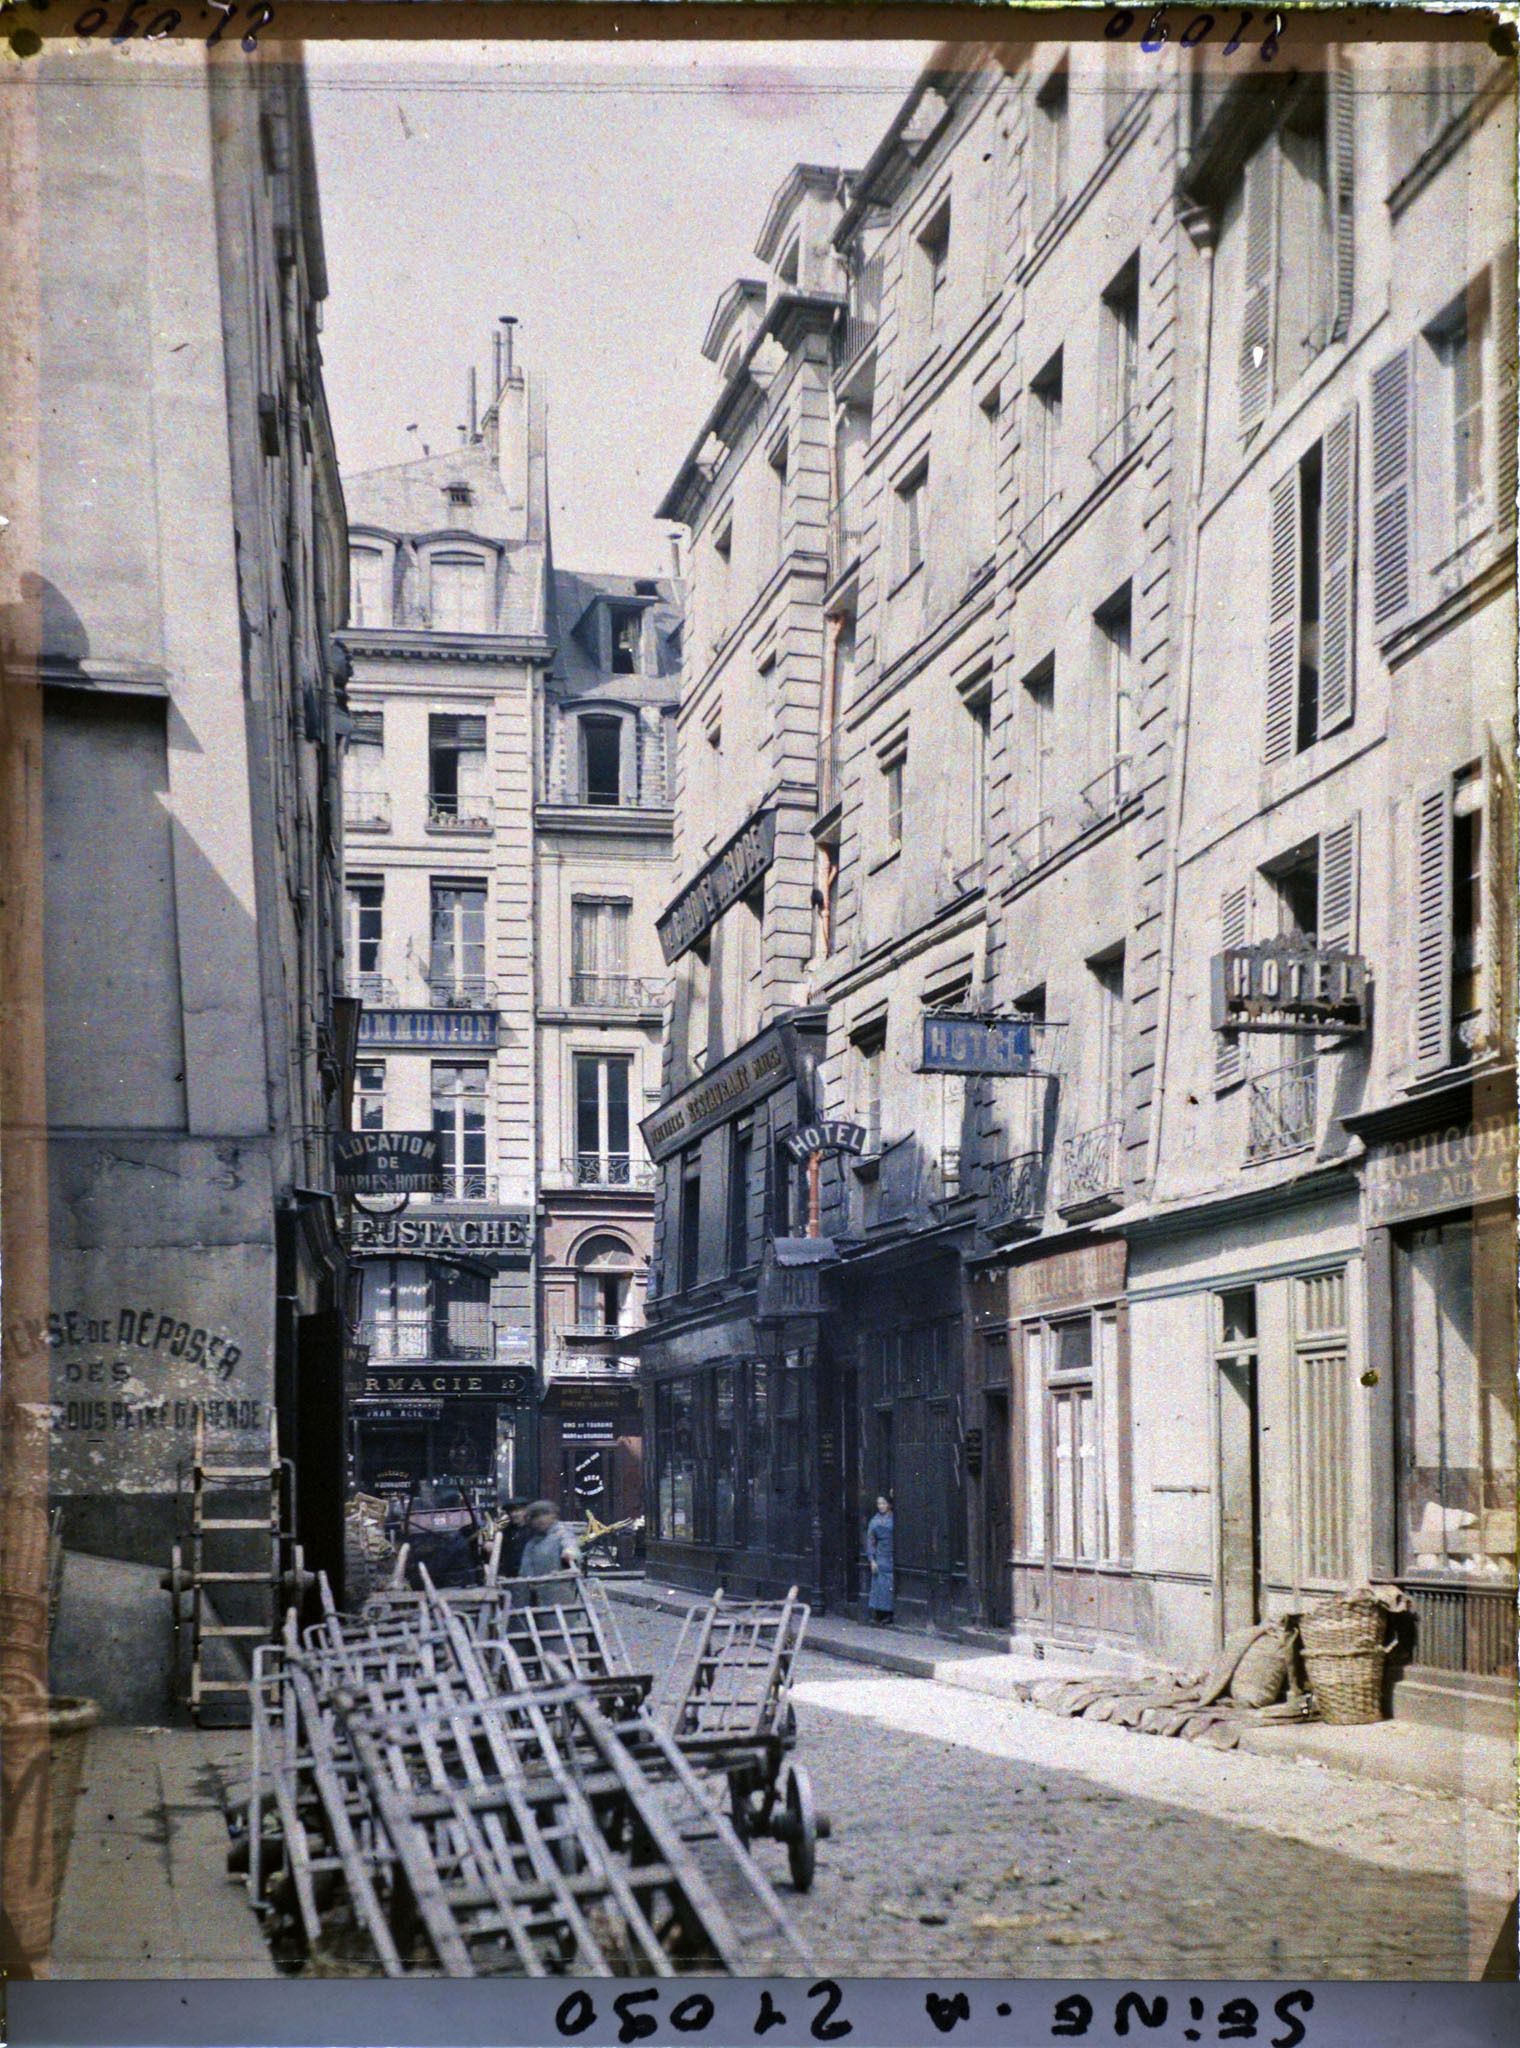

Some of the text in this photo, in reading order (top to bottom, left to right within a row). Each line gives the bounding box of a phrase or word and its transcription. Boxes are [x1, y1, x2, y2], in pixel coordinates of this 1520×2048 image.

[1233, 957, 1357, 999] HOTEL
[931, 1026, 1023, 1061] HOTEL
[338, 1133, 437, 1159] LOCATION
[788, 1123, 861, 1157] HOTEL
[377, 1156, 399, 1169] DE
[354, 1220, 521, 1245] EUSTACHE
[88, 1319, 112, 1343] DE
[66, 1362, 130, 1383] DES
